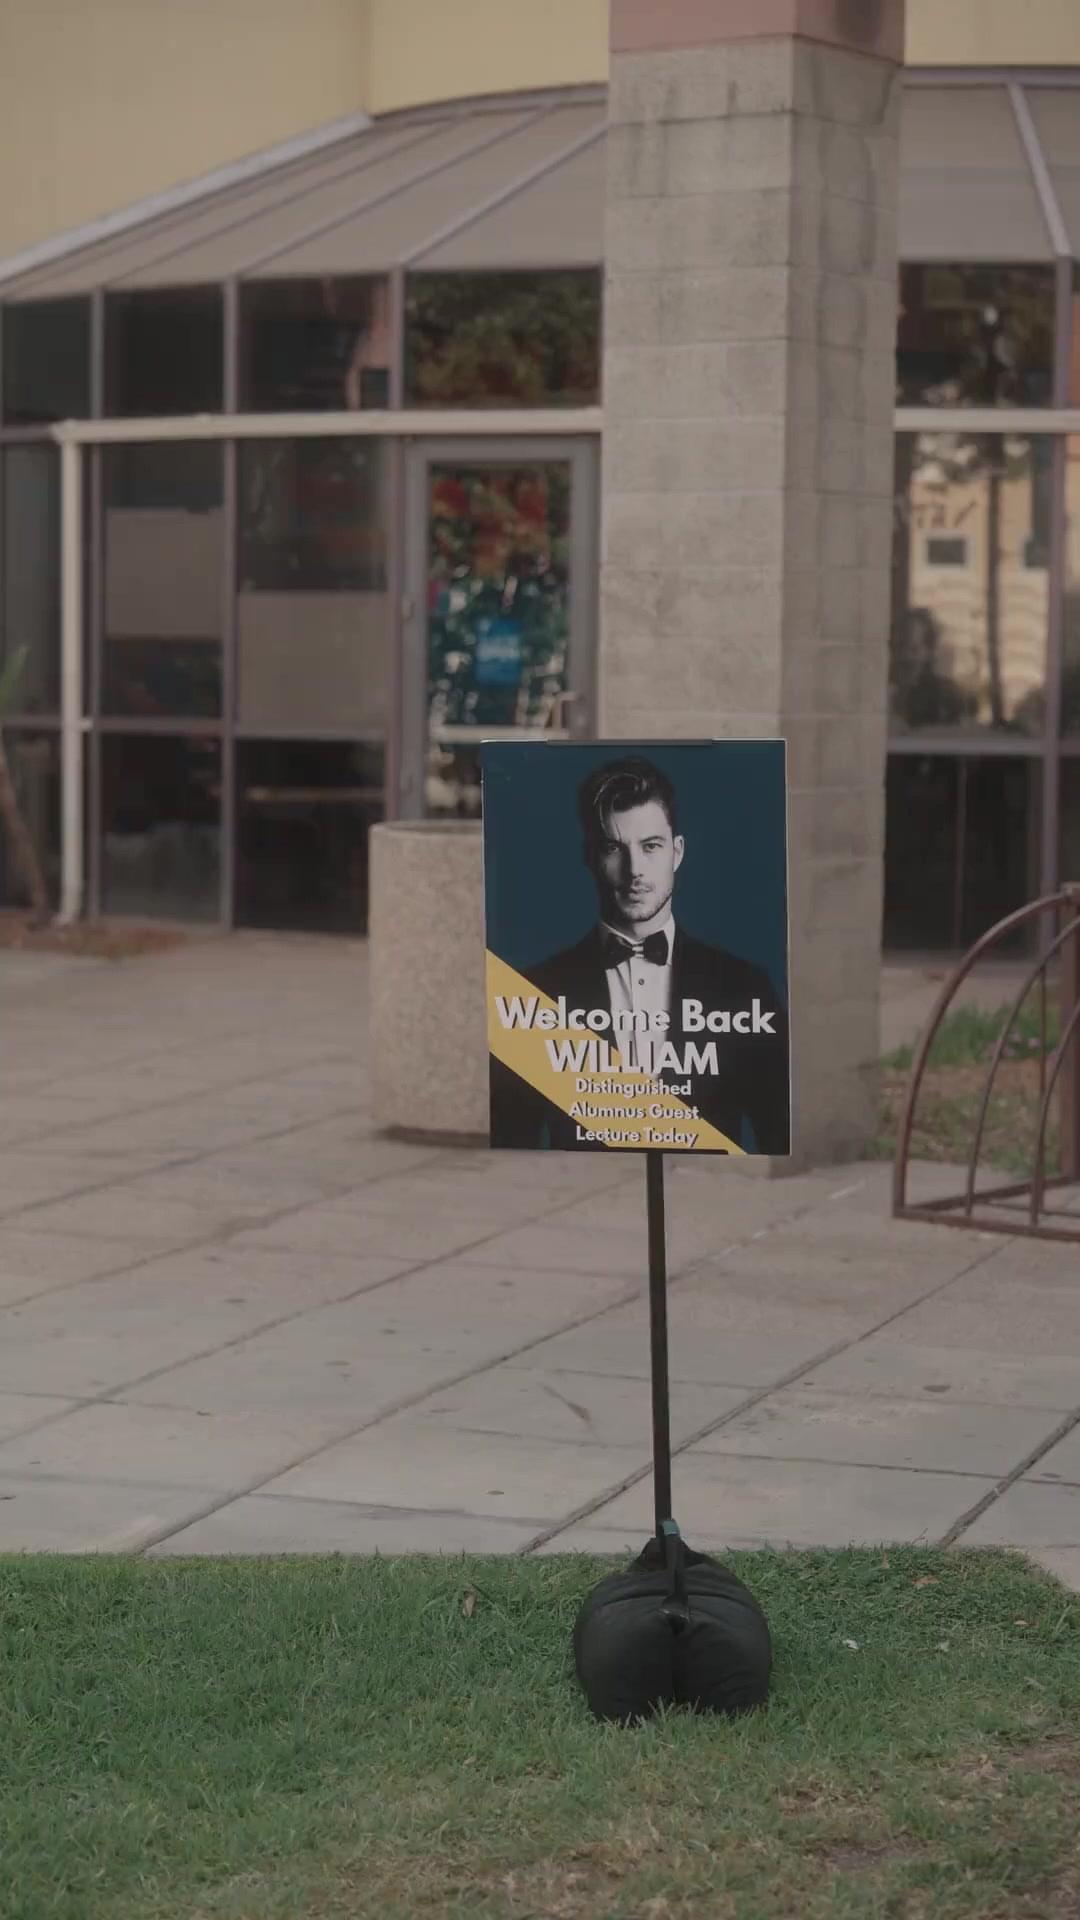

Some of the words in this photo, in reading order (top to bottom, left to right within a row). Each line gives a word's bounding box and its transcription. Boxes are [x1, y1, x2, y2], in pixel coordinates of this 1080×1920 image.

[495, 996, 670, 1031] Welcome
[681, 998, 776, 1034] Back
[545, 1039, 719, 1075] WILLIAM
[575, 1077, 692, 1098] Distinguished
[568, 1101, 646, 1119] Alumnus
[650, 1103, 700, 1121] Guest
[576, 1126, 640, 1142] Lecture
[645, 1127, 699, 1147] Today
